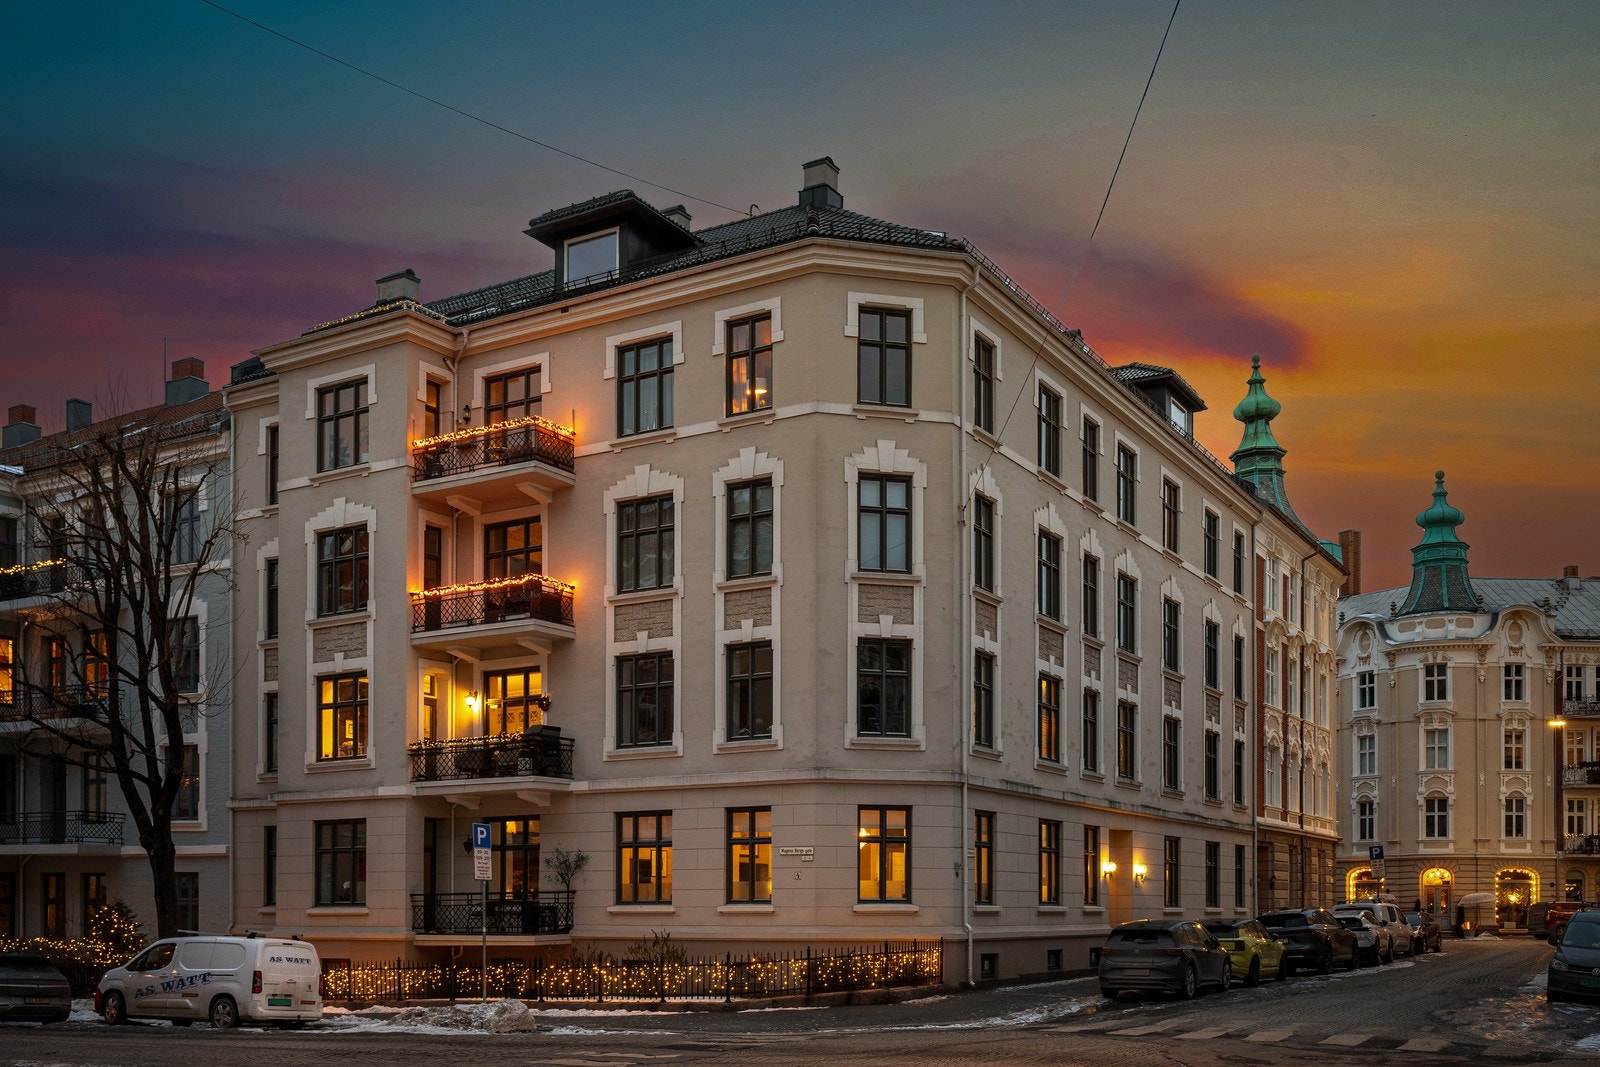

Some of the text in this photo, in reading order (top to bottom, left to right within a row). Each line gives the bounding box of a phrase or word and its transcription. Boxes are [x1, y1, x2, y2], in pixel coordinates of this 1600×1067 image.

[478, 827, 486, 844] P
[1373, 848, 1380, 858] P
[285, 956, 312, 965] WATT
[136, 972, 212, 999] AS WATT
